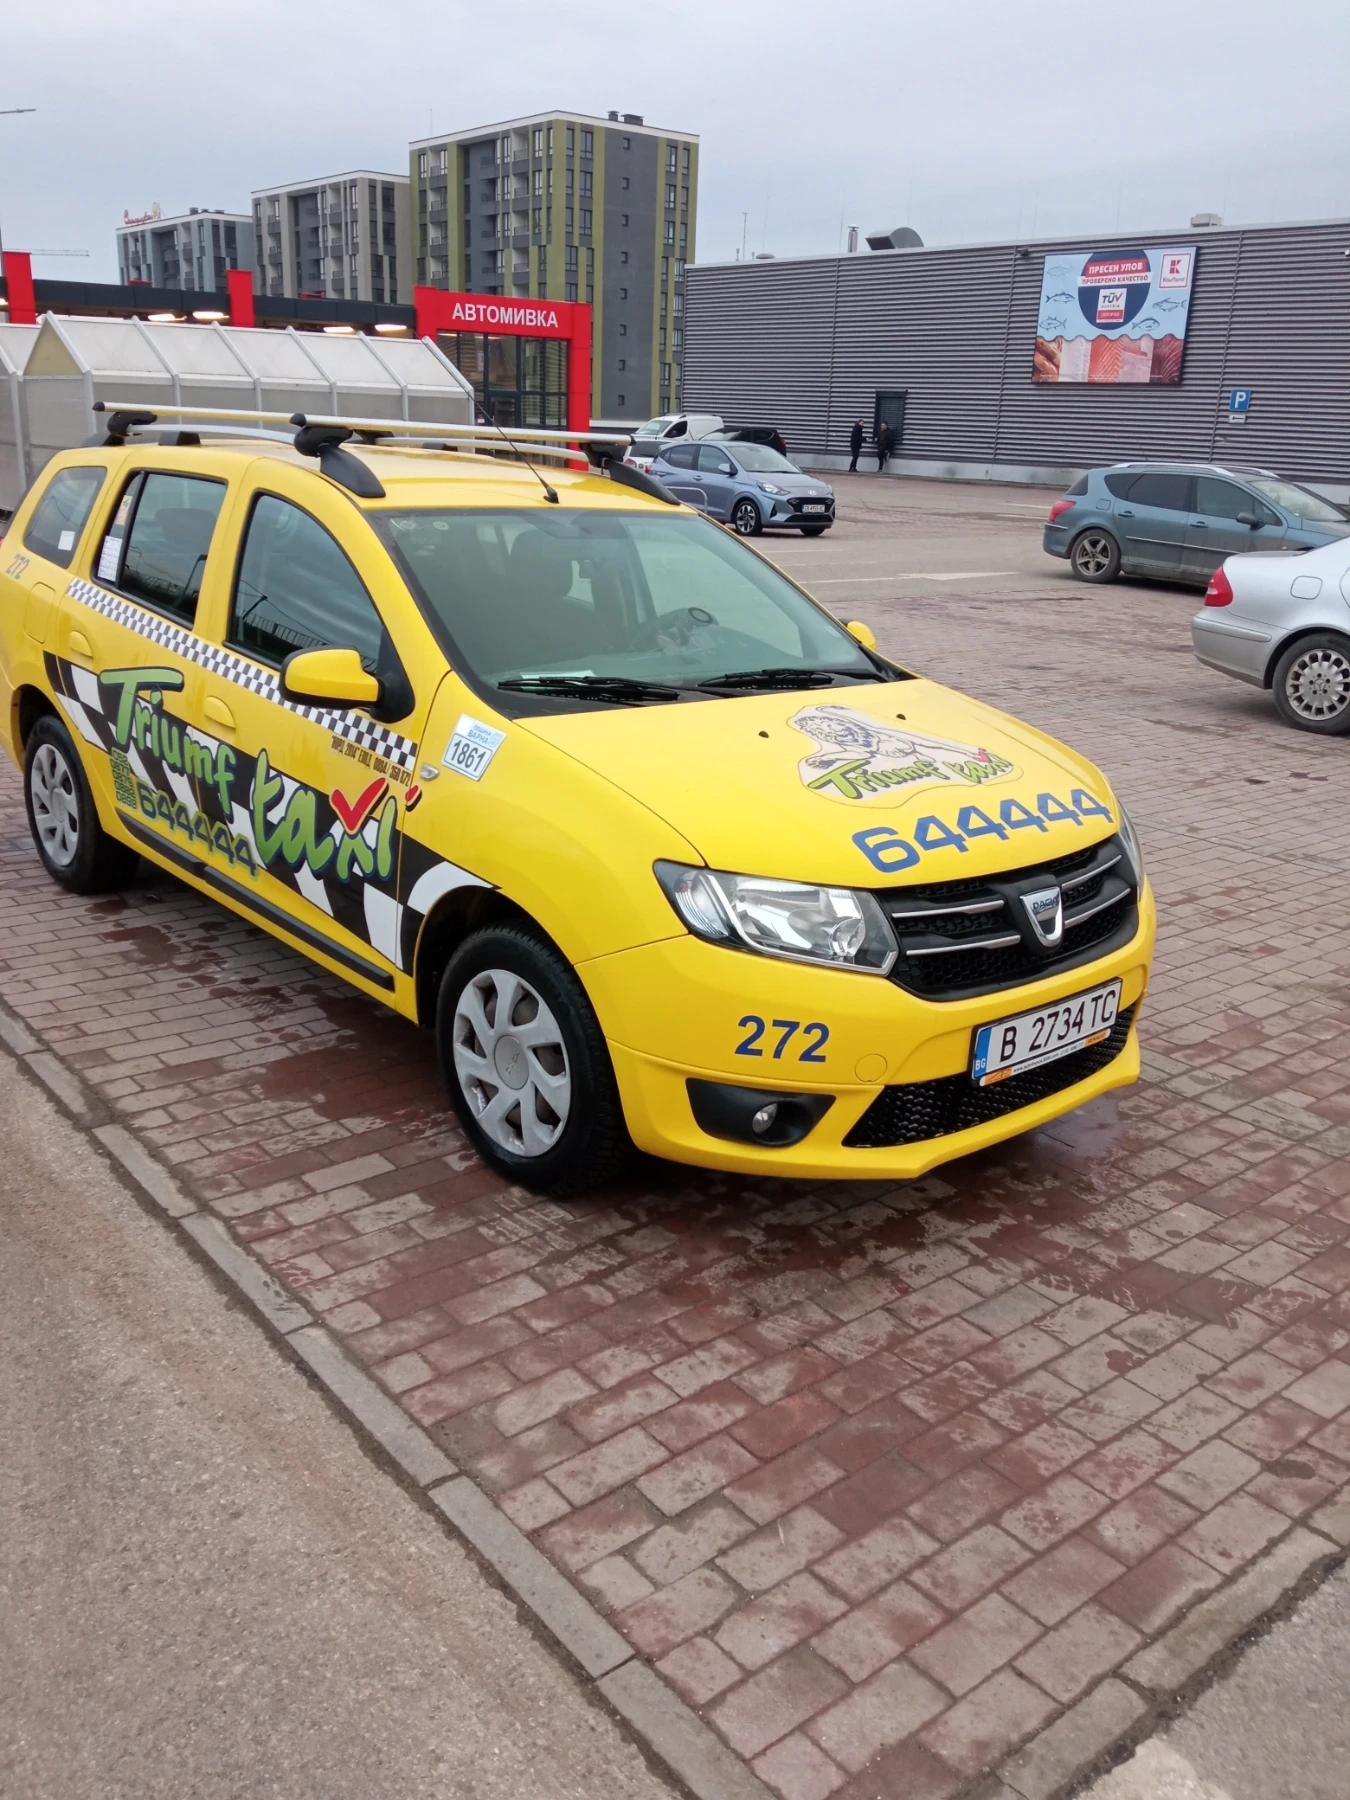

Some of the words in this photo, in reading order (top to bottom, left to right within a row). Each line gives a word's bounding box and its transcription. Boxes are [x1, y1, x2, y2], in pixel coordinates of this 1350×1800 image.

[1081, 276, 1117, 285] ПРОВЕРЕНО
[1117, 274, 1149, 283] КАЧЕСТВО
[1088, 264, 1119, 274] ПРЕСЕН
[1120, 262, 1143, 272] УЛОВ
[452, 302, 559, 328] АВТОМИВКА
[1234, 391, 1247, 409] P
[5, 553, 30, 580] 272
[467, 729, 489, 744] ВАРНА
[451, 740, 486, 772] 1861
[100, 667, 236, 824] Triumf
[251, 748, 419, 883] taxi
[808, 759, 950, 799] Triumf
[137, 780, 258, 880] 644444
[851, 788, 1115, 873] 644444
[734, 1014, 830, 1063] 272
[999, 1025, 1018, 1064] B
[1028, 1001, 1086, 1053] 2734
[1090, 989, 1116, 1028] TC
[974, 1057, 987, 1071] BG
